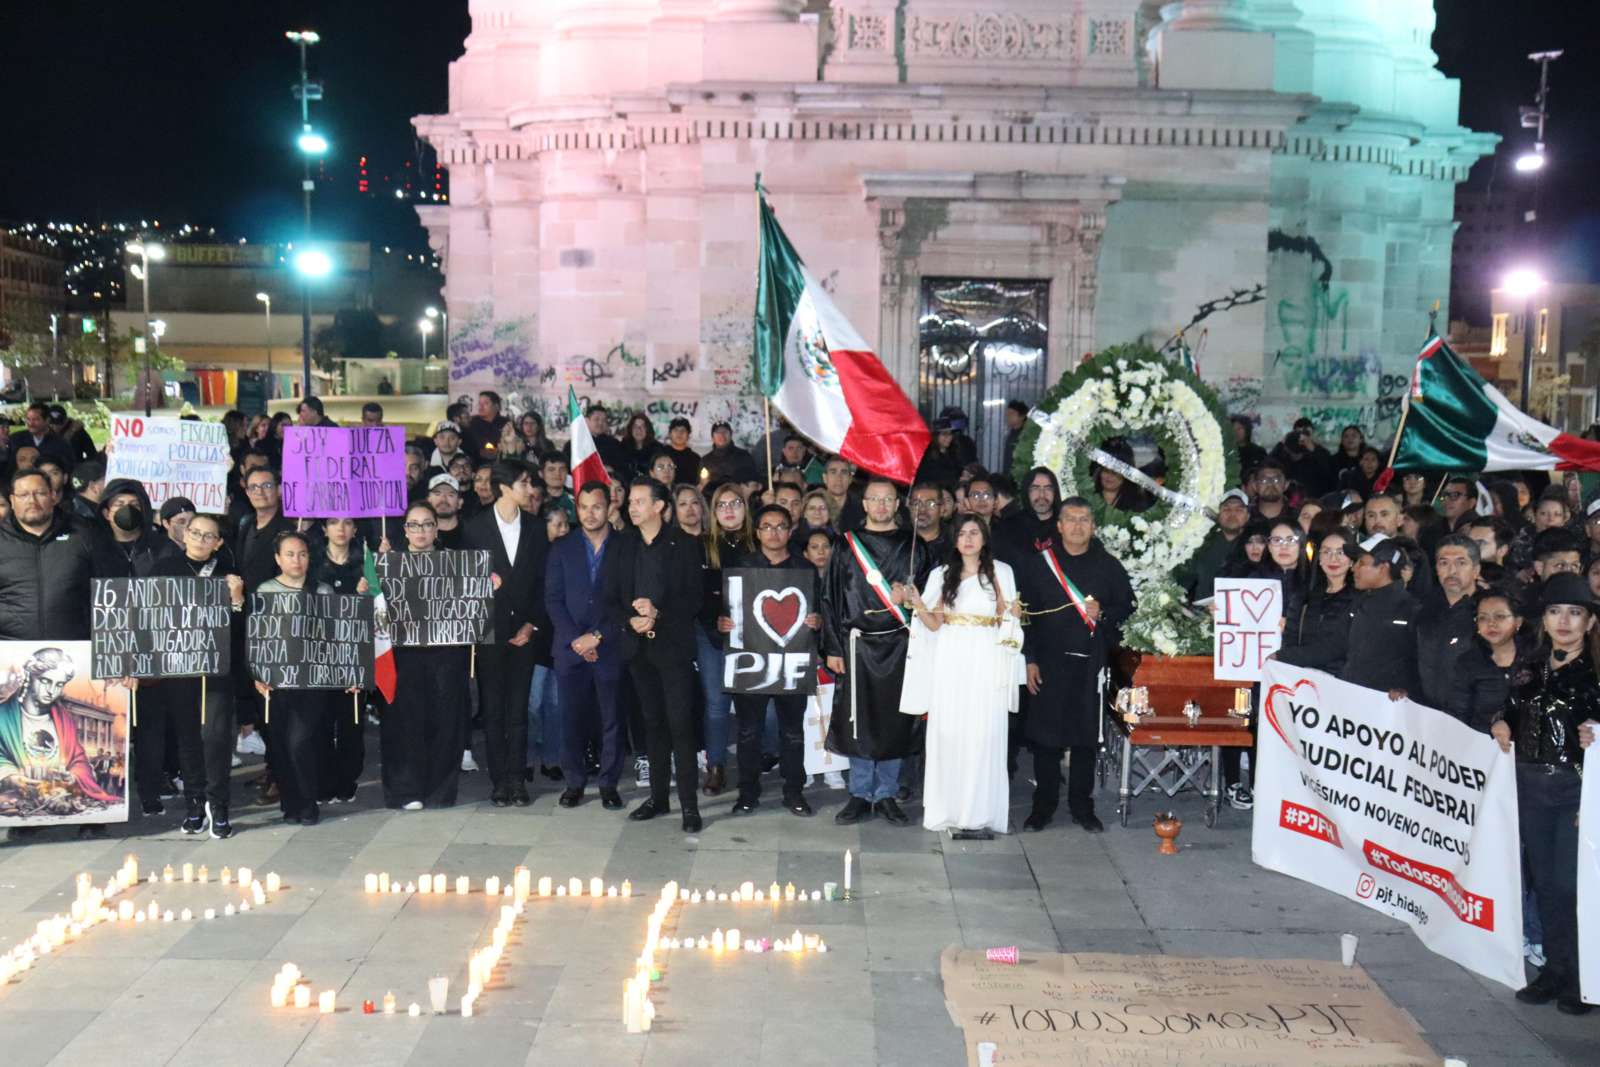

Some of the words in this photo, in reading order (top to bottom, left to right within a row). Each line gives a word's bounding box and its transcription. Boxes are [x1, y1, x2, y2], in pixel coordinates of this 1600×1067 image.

[114, 417, 144, 438] NO
[291, 428, 328, 455] SOY
[349, 428, 395, 455] JUEZA
[304, 455, 381, 480] FEDERAL
[283, 481, 298, 512] DE
[359, 480, 406, 511] JUDICIAL
[125, 578, 161, 607] AÑOS
[271, 592, 301, 614] AÑOS
[340, 595, 364, 618] PJF
[93, 607, 130, 630] DESDE
[728, 576, 744, 649] I
[1216, 589, 1240, 627] I
[248, 615, 283, 638] DESDE
[95, 631, 139, 653] HASTA
[249, 640, 288, 663] HASTA
[300, 640, 360, 666] JUZGADORA
[1219, 631, 1275, 670] PJF
[131, 653, 154, 676] SOY
[279, 665, 299, 687] SOY
[724, 651, 811, 691] PJF
[1288, 701, 1320, 729] YO
[1324, 714, 1404, 756] APOYO
[1408, 740, 1426, 768] AL
[1429, 749, 1486, 793] PODER
[1300, 739, 1398, 793] JUDICIAL
[1364, 801, 1420, 838] NOVENO
